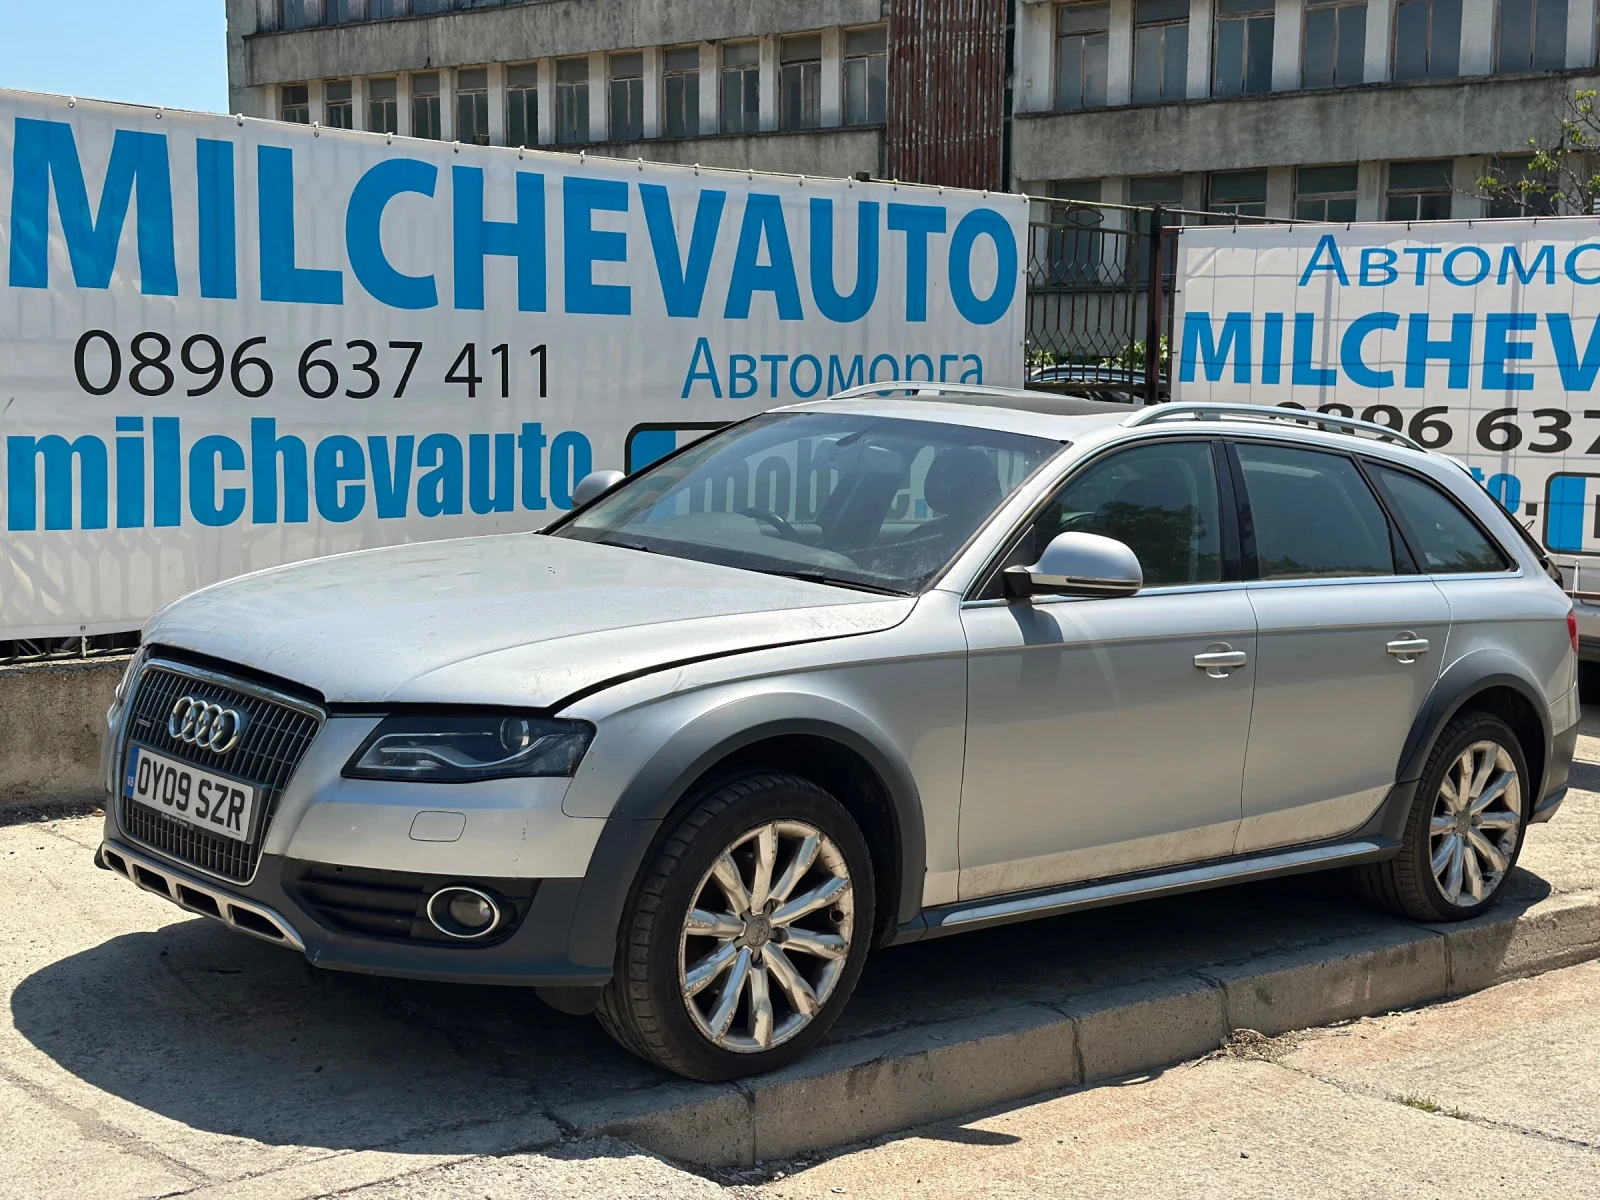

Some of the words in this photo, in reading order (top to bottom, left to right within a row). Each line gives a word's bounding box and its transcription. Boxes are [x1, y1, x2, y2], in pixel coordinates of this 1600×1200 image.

[8, 117, 1018, 325] MILCHEVAUTO
[74, 329, 274, 398] 0896
[298, 338, 423, 400] 637
[444, 342, 547, 398] 411
[1179, 311, 1600, 392] MILCHEV
[7, 416, 593, 531] milchevauto
[195, 778, 246, 832] SZR
